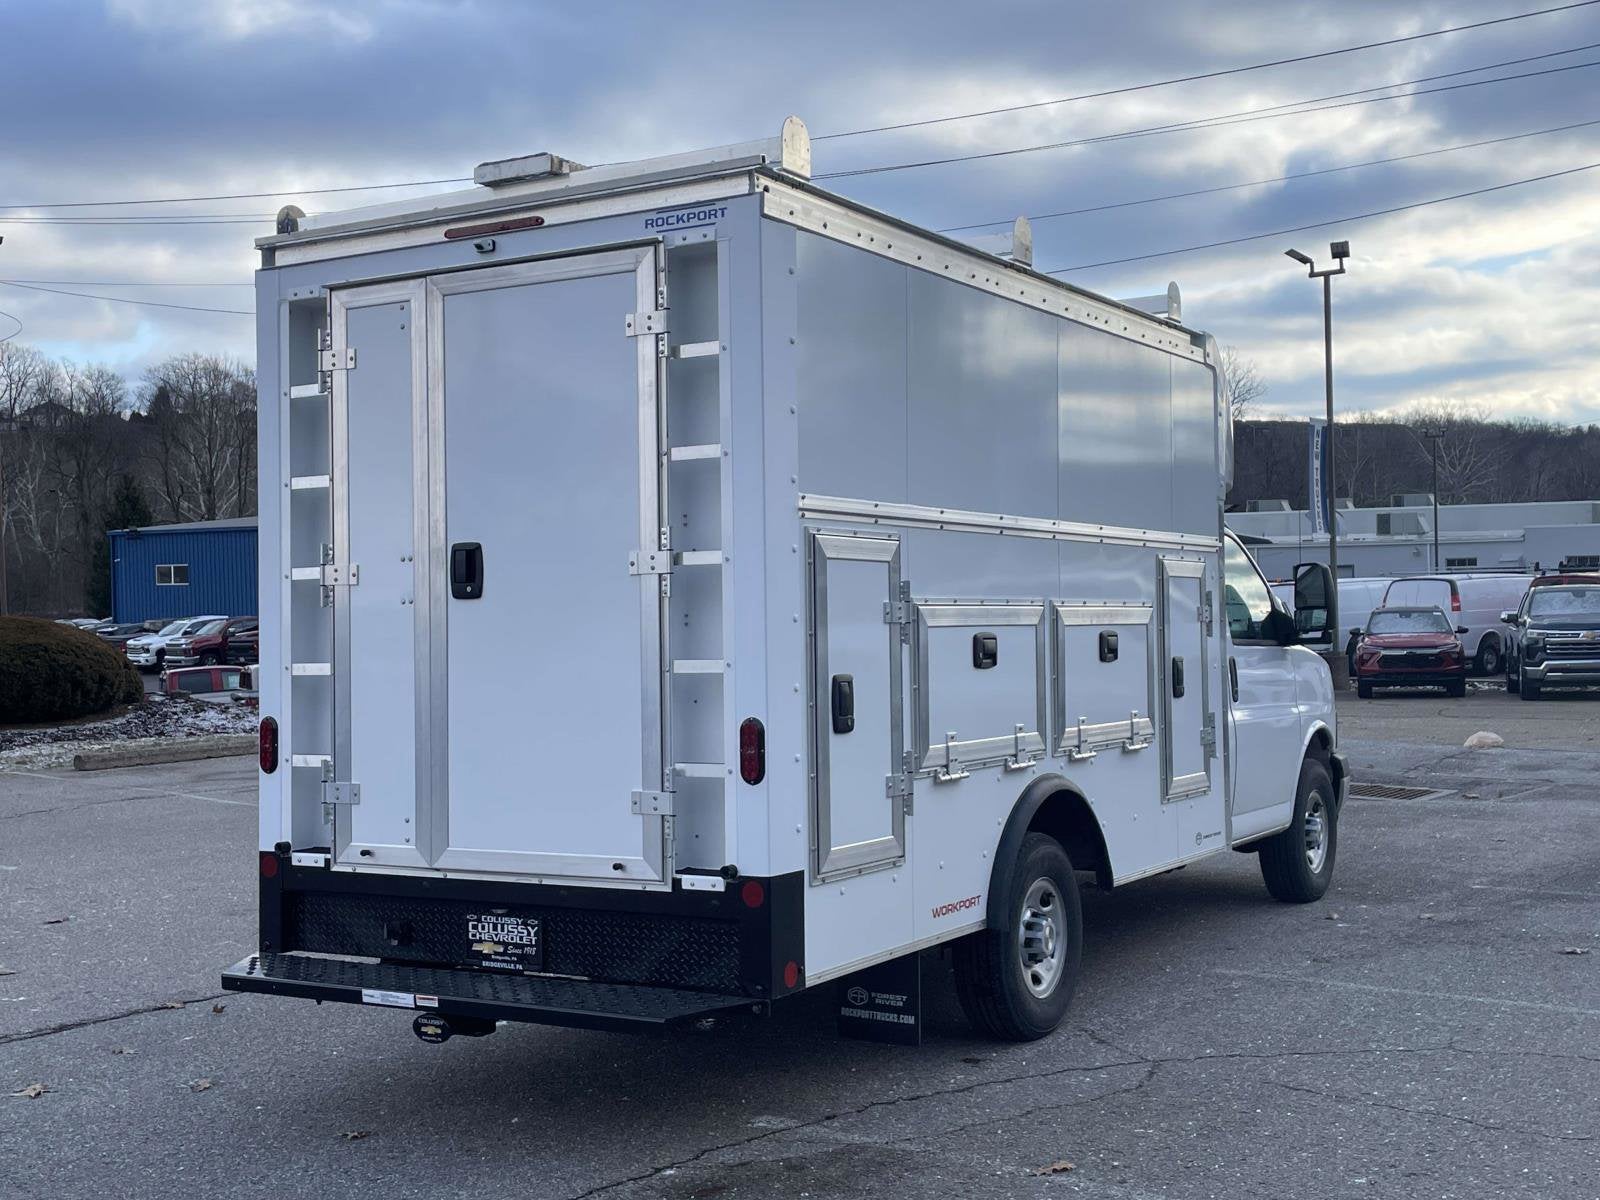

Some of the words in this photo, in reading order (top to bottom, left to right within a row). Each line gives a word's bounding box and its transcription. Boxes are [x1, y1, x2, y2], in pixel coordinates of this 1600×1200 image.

[644, 207, 728, 229] ROCKPORT
[932, 895, 982, 918] WORKPORT
[481, 915, 524, 925] COLUSSY
[468, 921, 538, 937] COLUSSY
[468, 931, 538, 945] CHEVROLET
[875, 998, 904, 1007] RIVER
